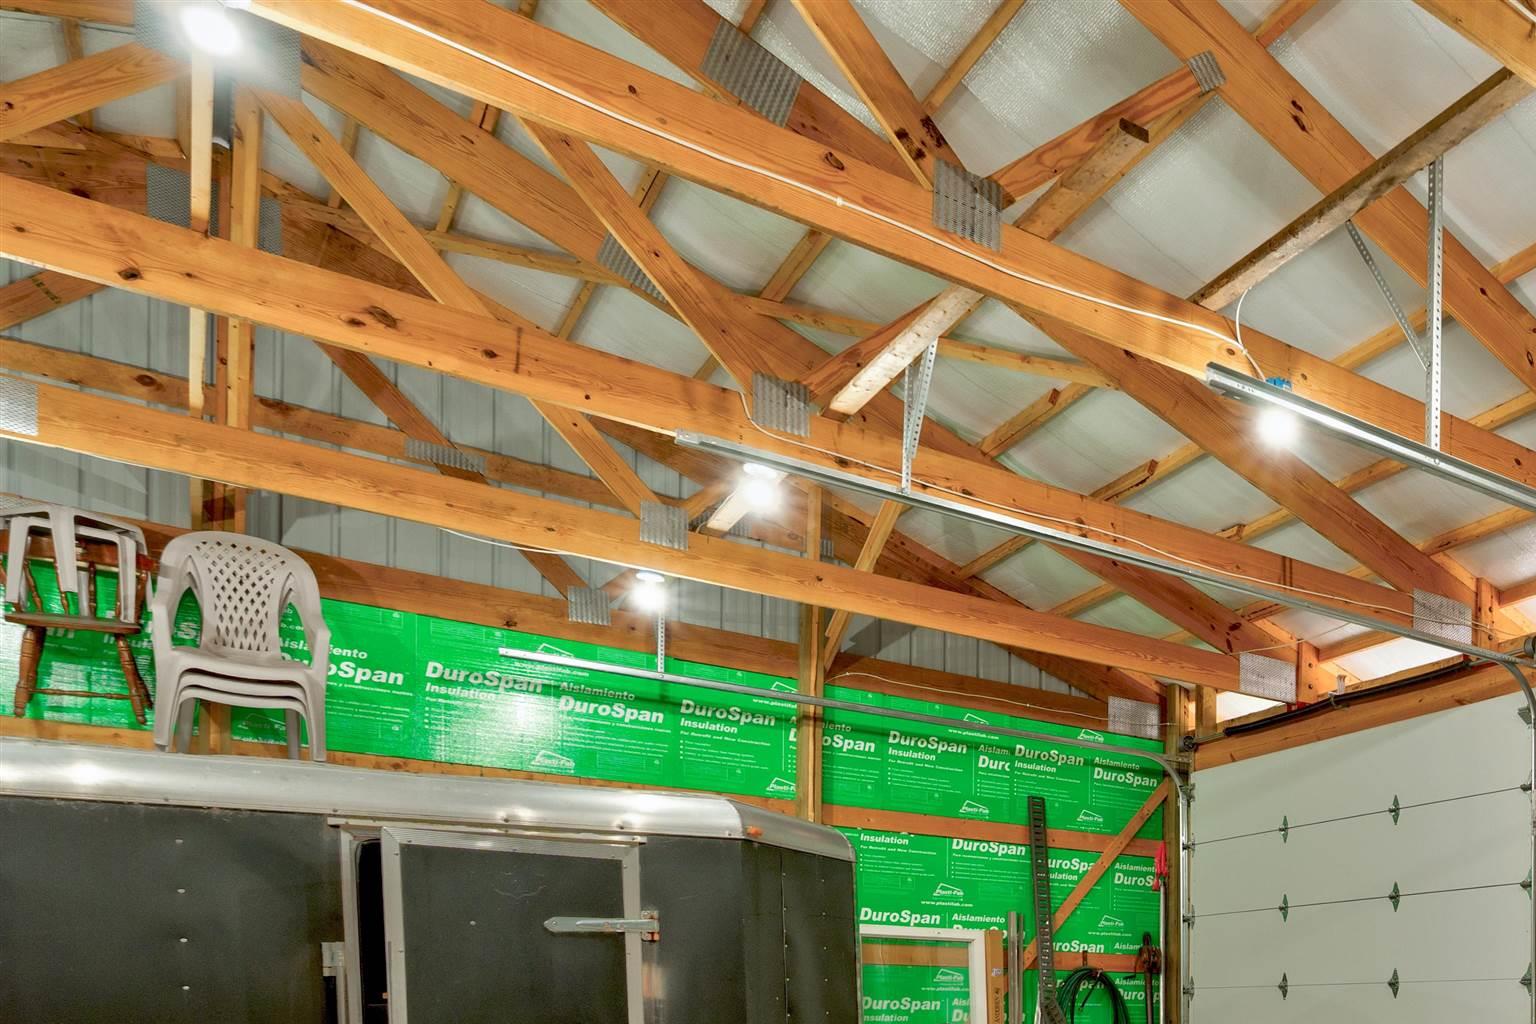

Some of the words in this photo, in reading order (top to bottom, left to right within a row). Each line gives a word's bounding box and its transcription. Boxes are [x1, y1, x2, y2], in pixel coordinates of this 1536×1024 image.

[425, 661, 543, 693] DuroSpan
[425, 682, 497, 700] Insulation
[560, 681, 635, 700] Aislamiento
[559, 695, 664, 723] DuroSpan
[680, 698, 776, 726] DuroSpan
[680, 718, 738, 734] Insulation
[822, 734, 876, 753] oSpan
[888, 730, 967, 754] DuroSpan
[978, 744, 1010, 756] Aislam
[888, 747, 936, 761] Insulation
[1014, 744, 1084, 766] DuroSpan
[1014, 760, 1057, 773] Insulation
[1094, 756, 1140, 770] Aislamiento
[1093, 767, 1157, 787] DuroSpan
[860, 832, 909, 845] Insulation
[952, 838, 1026, 857] DuroSpan
[1114, 862, 1157, 873] Aislamient
[1049, 873, 1078, 881] ulation
[1114, 872, 1157, 887] DuroS
[859, 907, 941, 926] DuroSpan
[952, 913, 1006, 924] Aislamiento
[863, 1014, 909, 1022] nsulation
